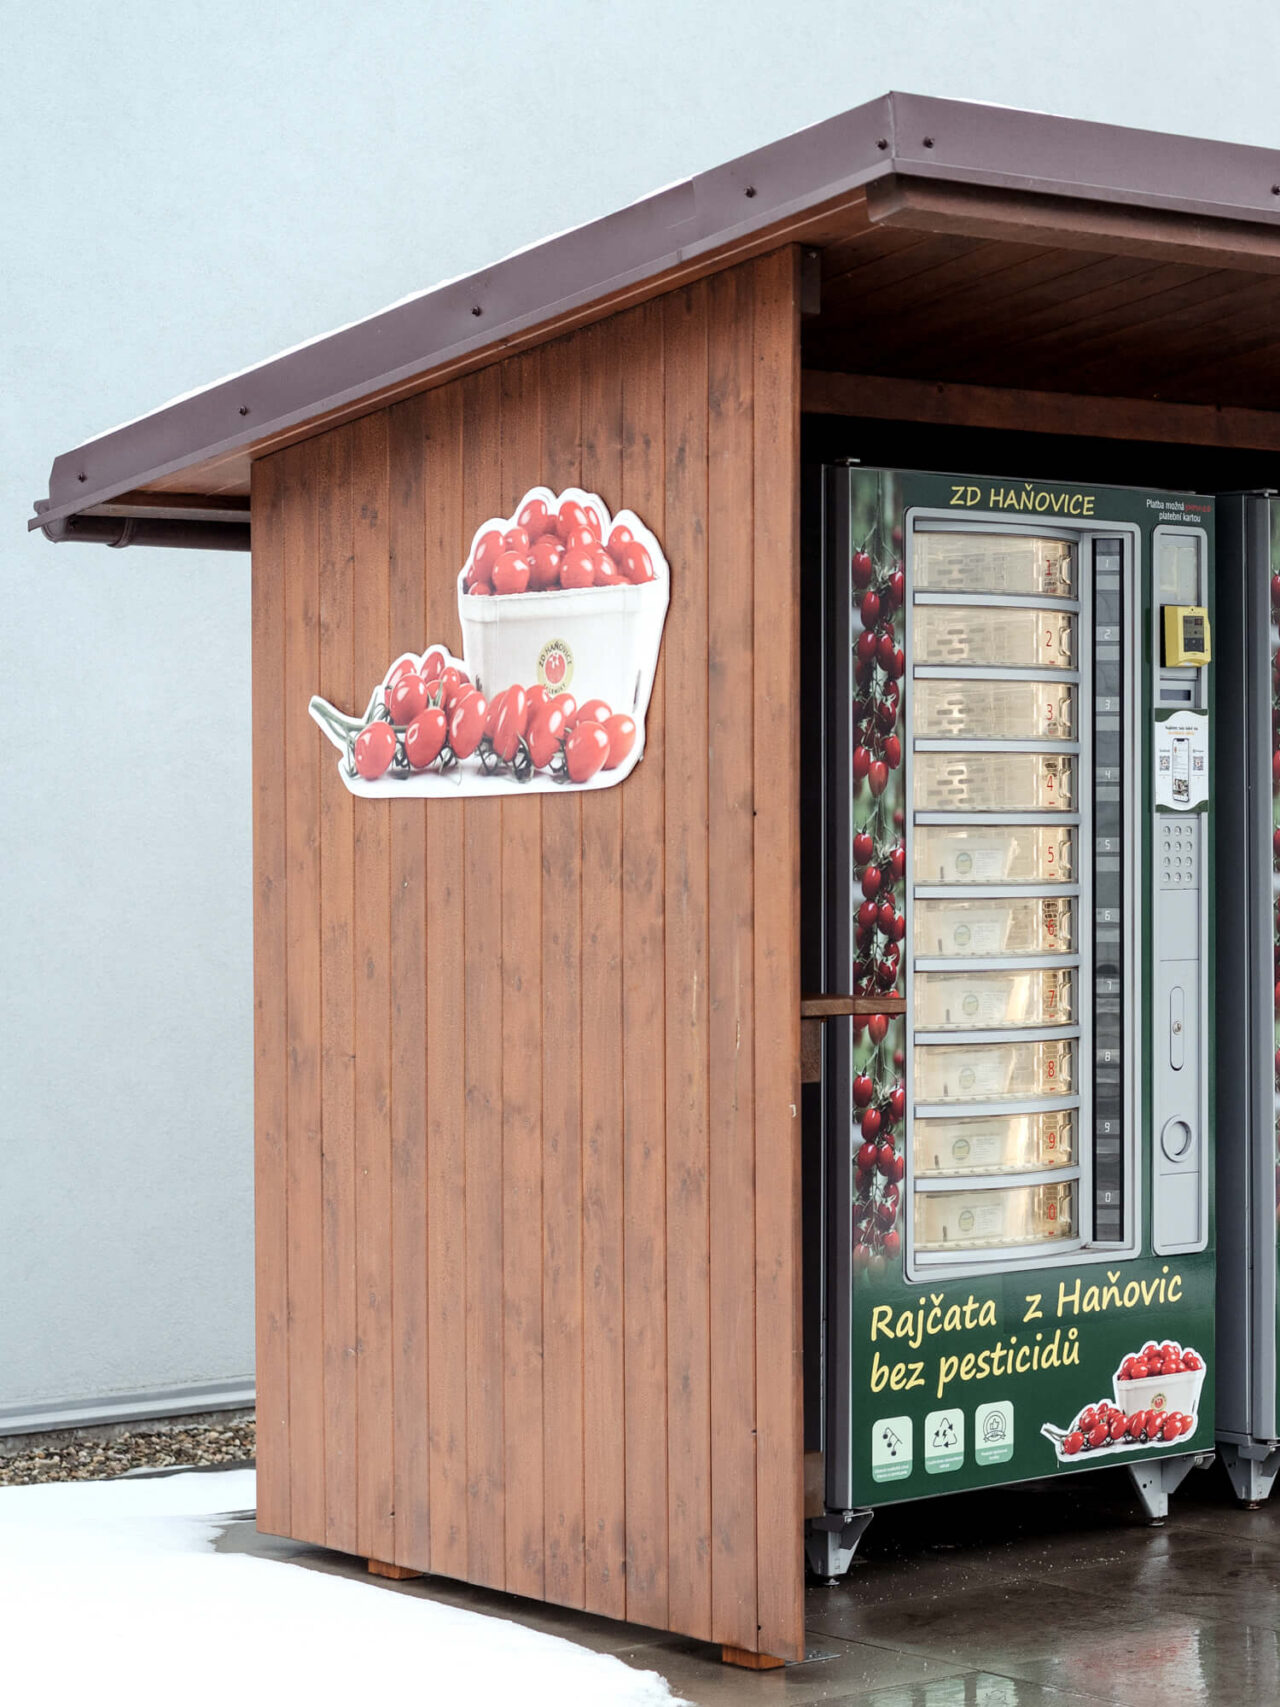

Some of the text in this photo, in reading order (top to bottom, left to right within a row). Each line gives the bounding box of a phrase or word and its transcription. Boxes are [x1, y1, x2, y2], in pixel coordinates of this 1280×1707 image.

[950, 483, 1094, 515] ZD HAŇOVICE
[1146, 498, 1165, 510] Platba
[1165, 500, 1185, 511] možná
[1159, 511, 1201, 523] platební kartou
[1045, 630, 1053, 648] 2
[1046, 775, 1055, 792] 4
[1104, 769, 1111, 780] 4
[1104, 839, 1111, 850] 5
[1047, 846, 1055, 864] 5
[1104, 910, 1111, 921] 6
[1047, 918, 1056, 937] 6
[1105, 980, 1112, 991] 7
[1047, 989, 1056, 1007] 7
[1047, 1060, 1056, 1079] 8
[1047, 1131, 1057, 1151] 9
[1048, 1203, 1057, 1221] 0
[870, 1266, 1182, 1349] Rajčata z Haňovic
[870, 1328, 1079, 1399] bez pesticidů
